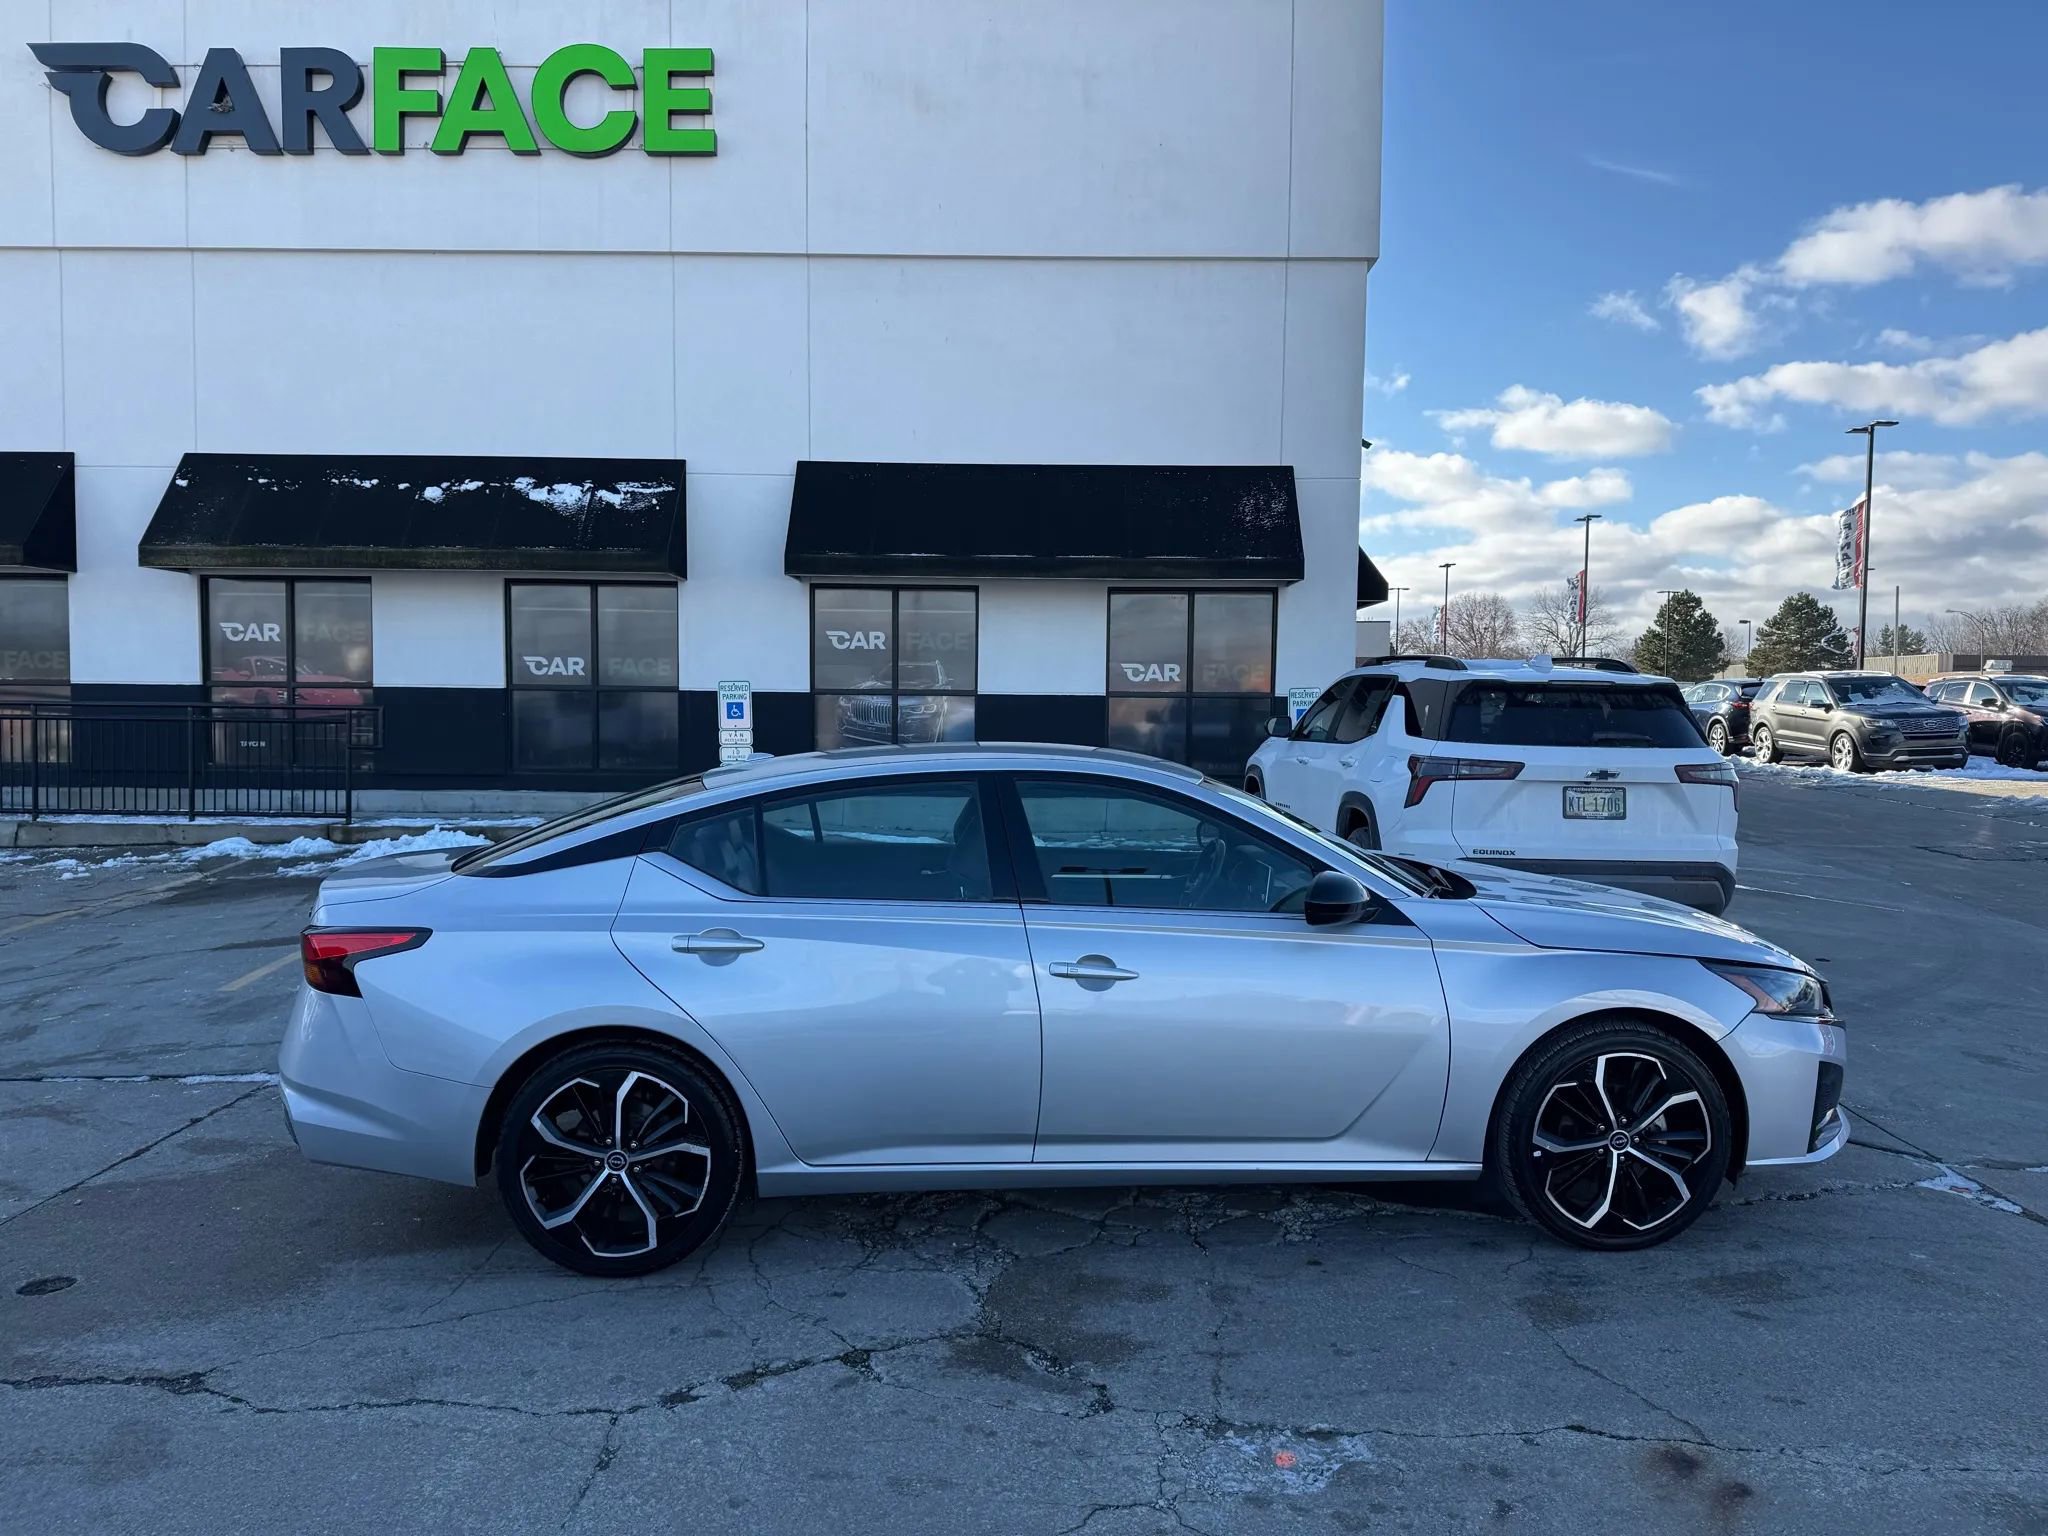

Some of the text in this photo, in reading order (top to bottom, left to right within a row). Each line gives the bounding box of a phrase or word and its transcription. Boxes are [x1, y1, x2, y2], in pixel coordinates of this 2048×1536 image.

[28, 43, 717, 158] CARFACE
[220, 622, 366, 643] CAR FACE
[827, 630, 968, 650] CAR FACE
[523, 656, 672, 676] CAR FACE
[1121, 663, 1181, 682] CAR
[720, 684, 749, 692] RESERVED
[1291, 691, 1320, 699] RESERVED
[722, 693, 748, 701] PARKING
[1293, 699, 1314, 707] PARKIN
[1568, 796, 1621, 813] KTL 1706
[1472, 848, 1516, 856] EQUINOX
